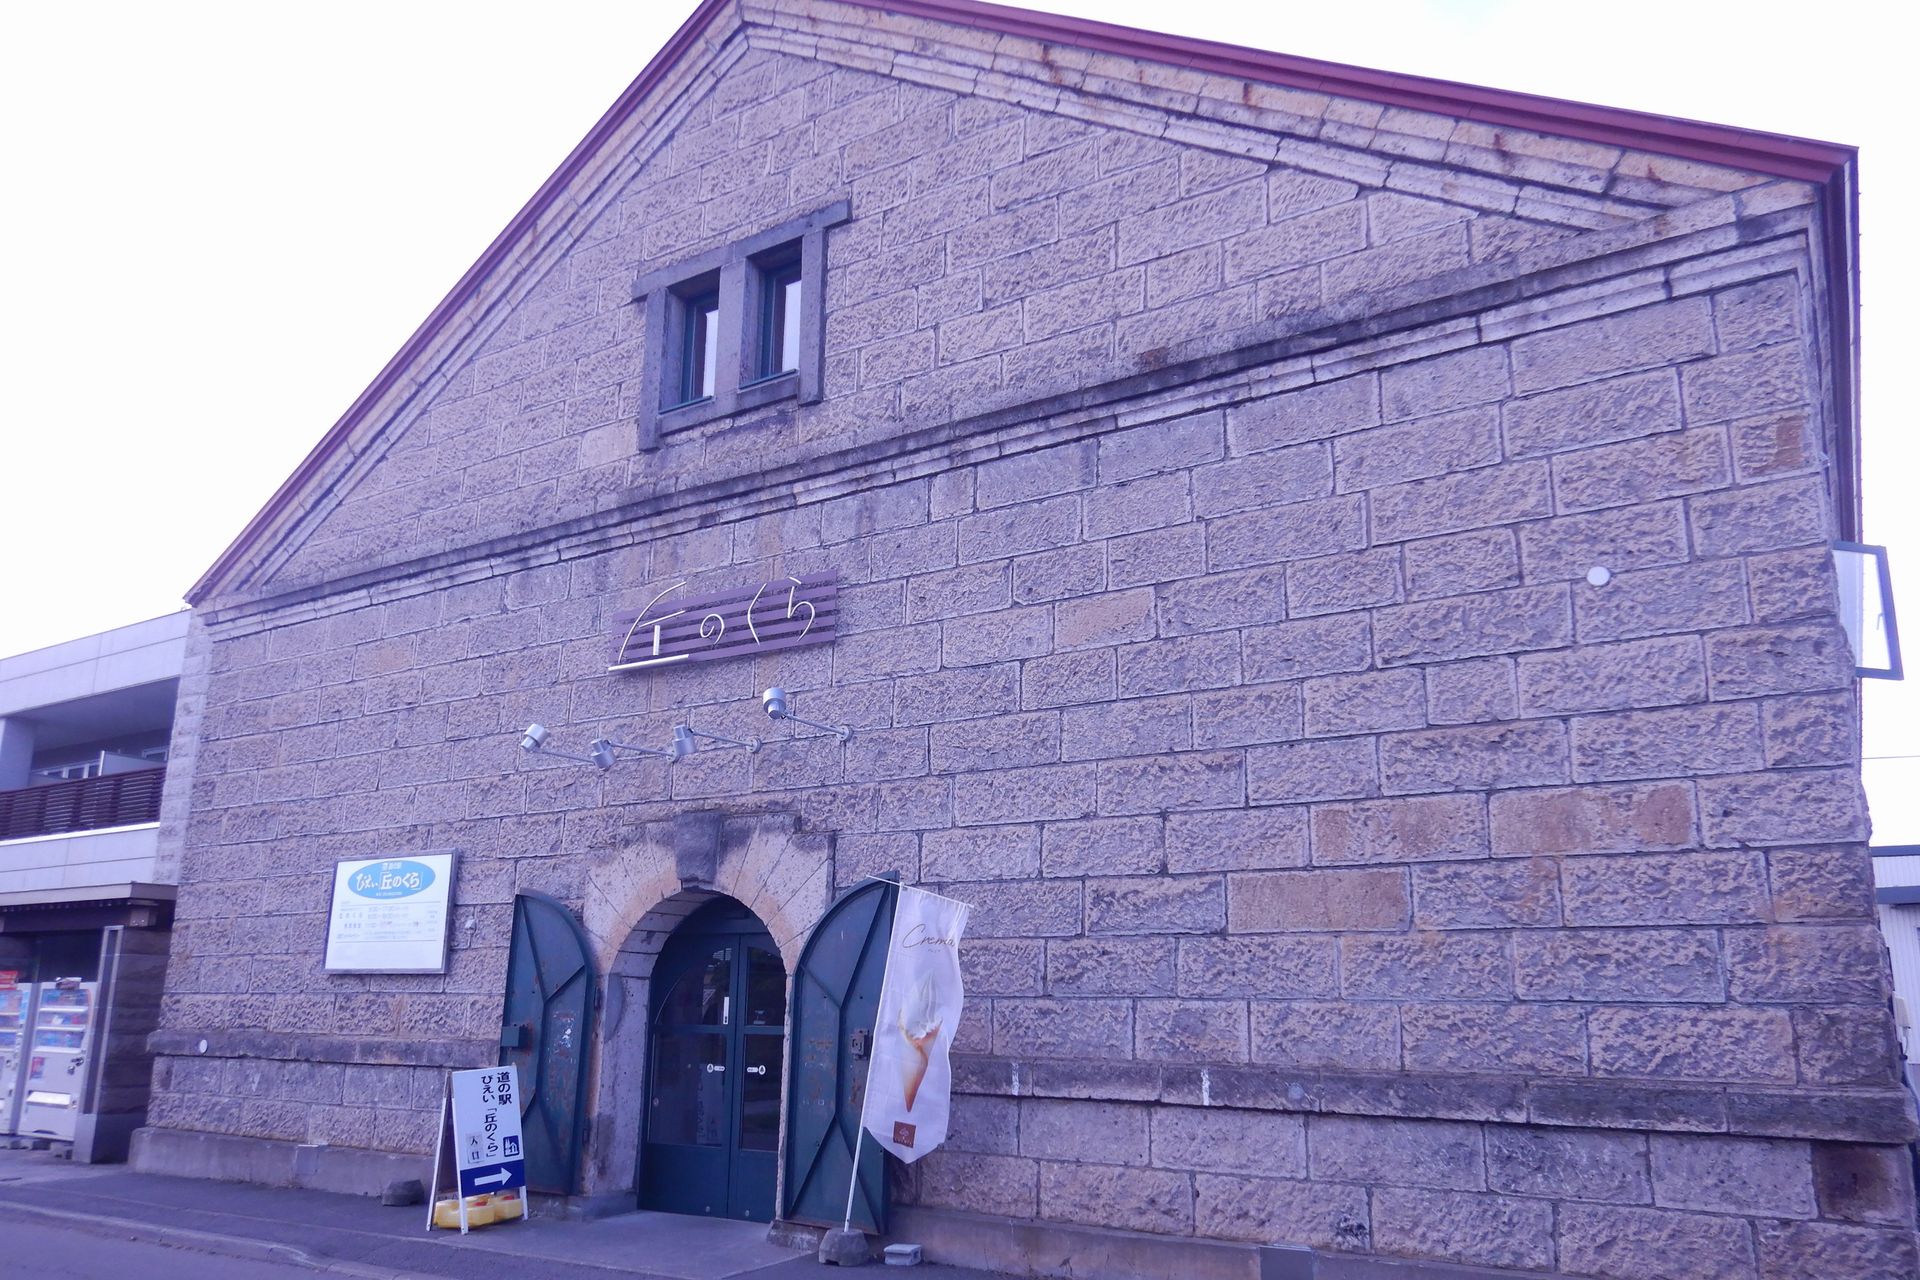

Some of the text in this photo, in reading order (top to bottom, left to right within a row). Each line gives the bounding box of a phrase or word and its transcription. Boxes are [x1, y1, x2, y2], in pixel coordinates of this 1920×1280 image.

[497, 1071, 512, 1105] 道の駅
[470, 1137, 480, 1160] 入口
